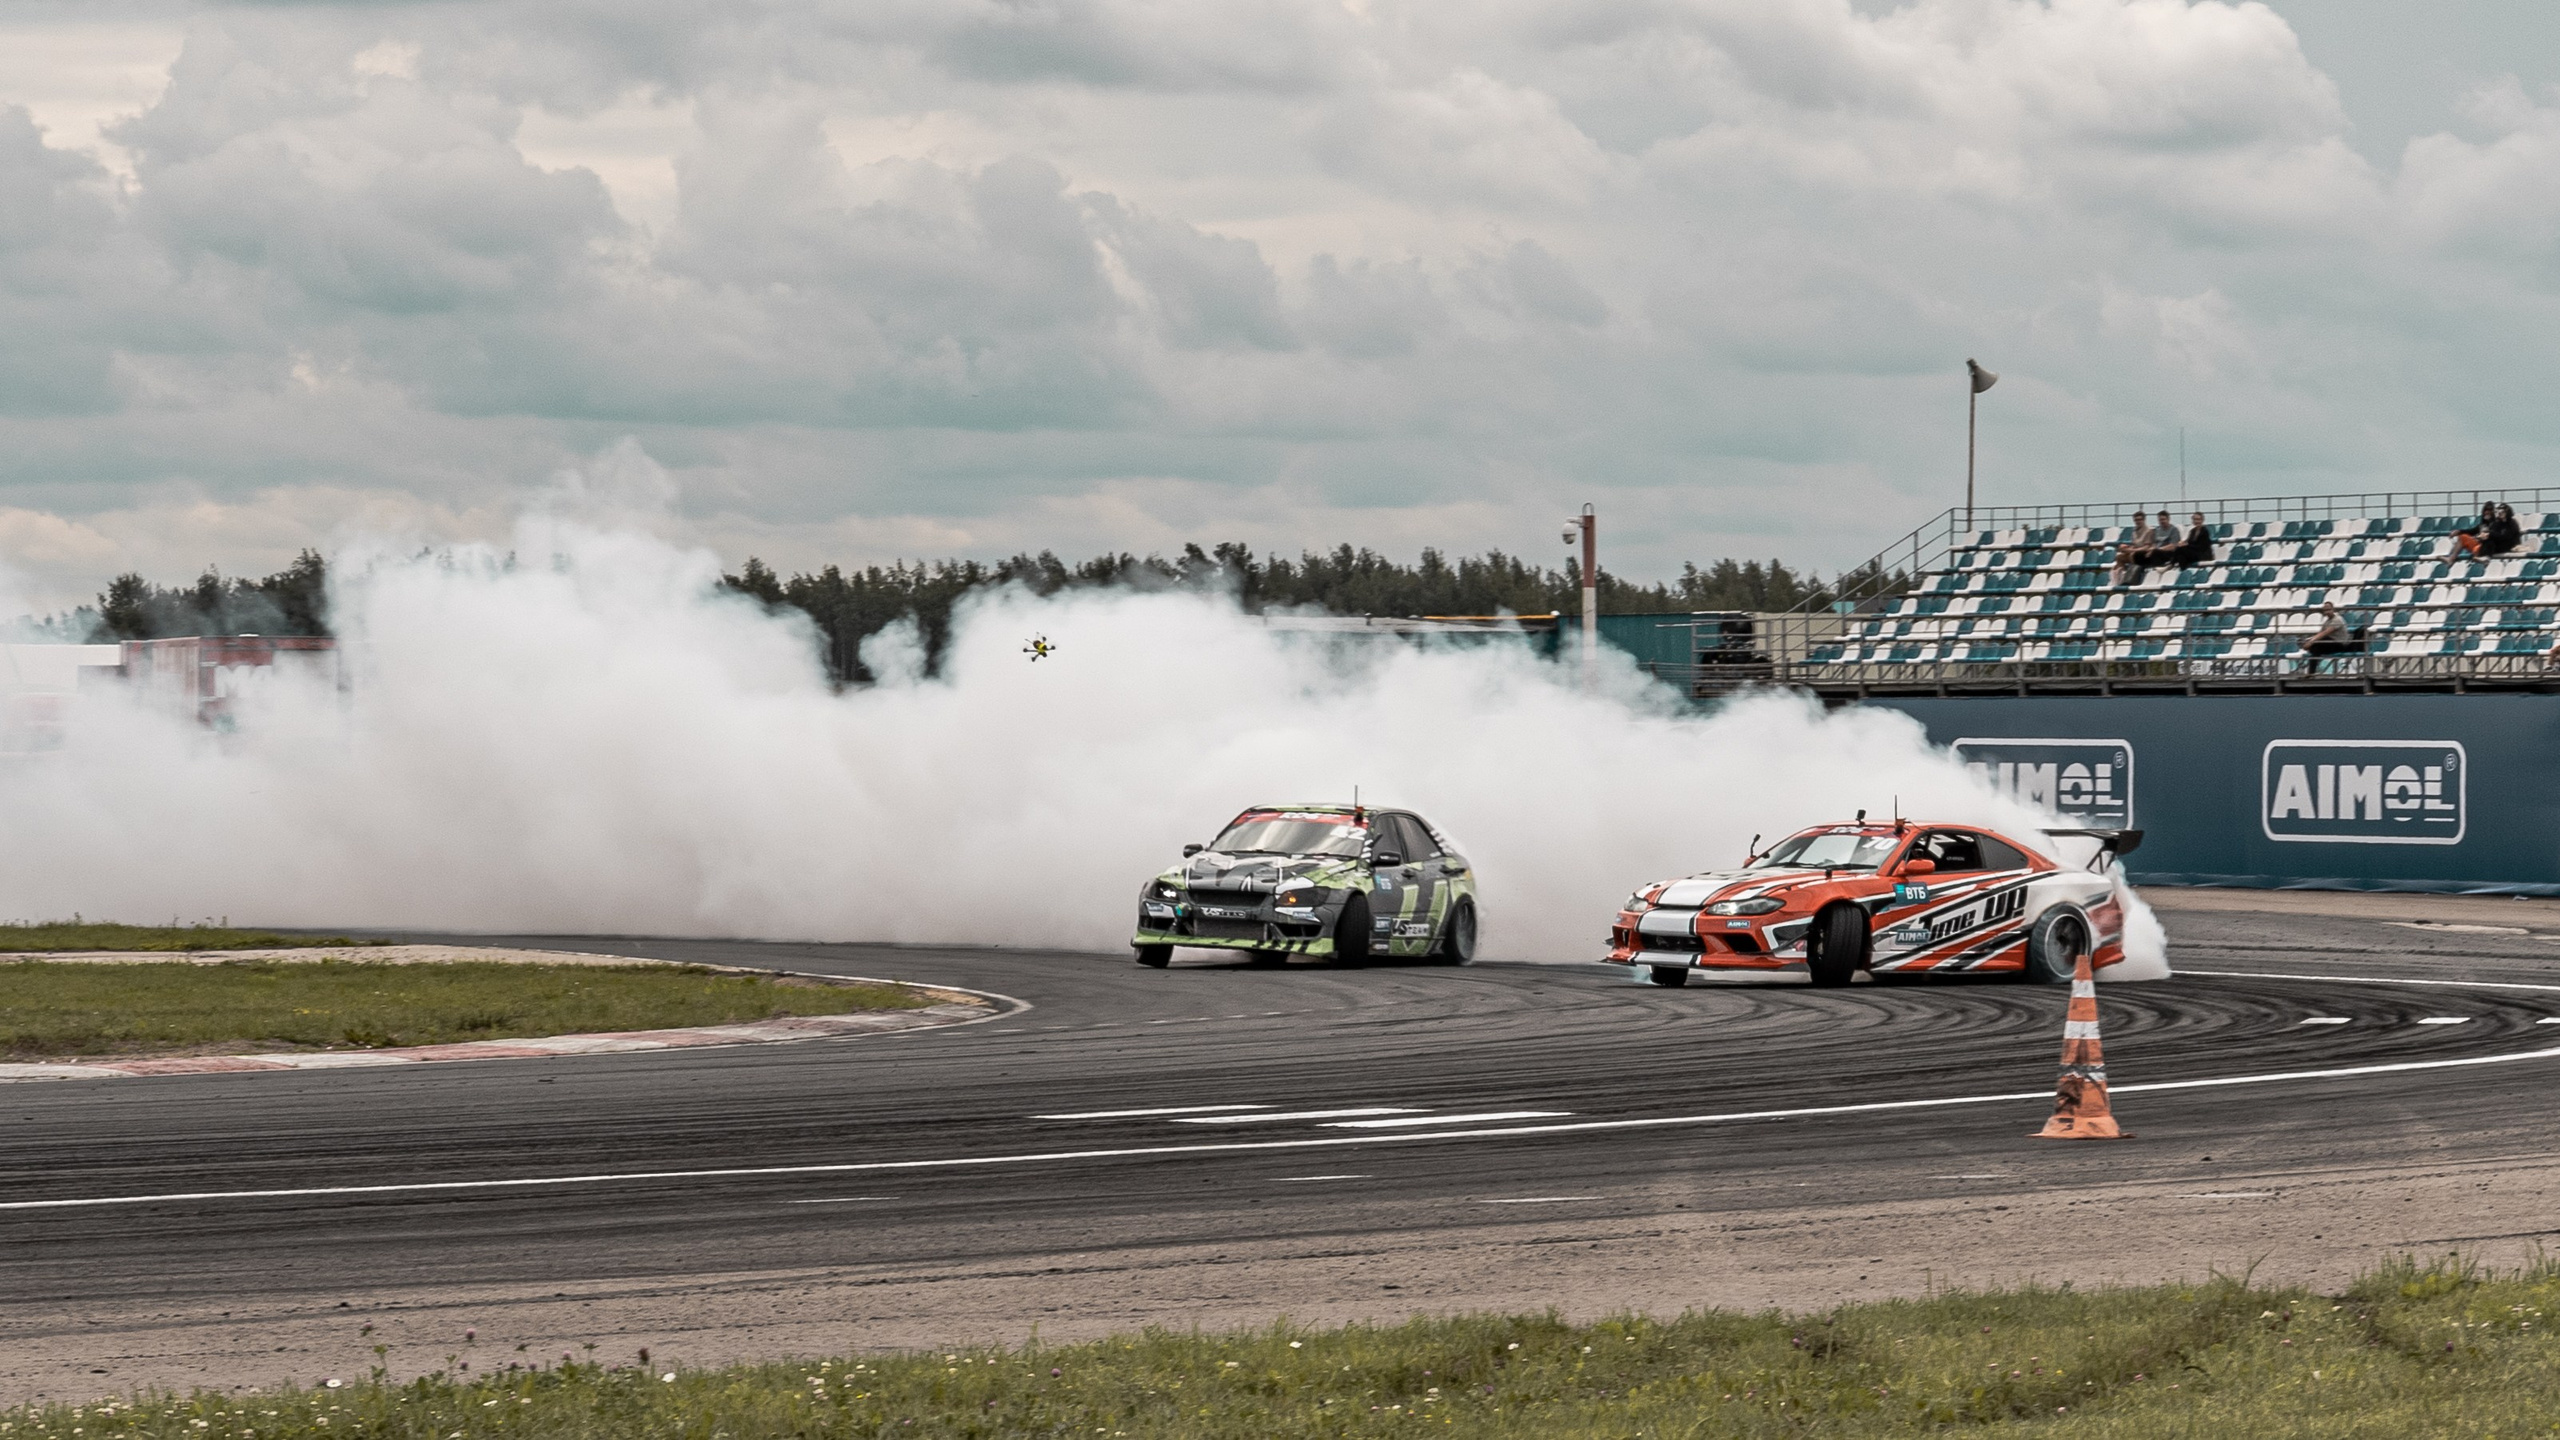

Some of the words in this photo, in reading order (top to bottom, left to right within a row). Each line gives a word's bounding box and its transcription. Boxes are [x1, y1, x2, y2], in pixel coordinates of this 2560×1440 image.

[2270, 764, 2456, 822] AIMOL
[1861, 836, 1900, 850] 70
[1906, 886, 1926, 900] ВТБ
